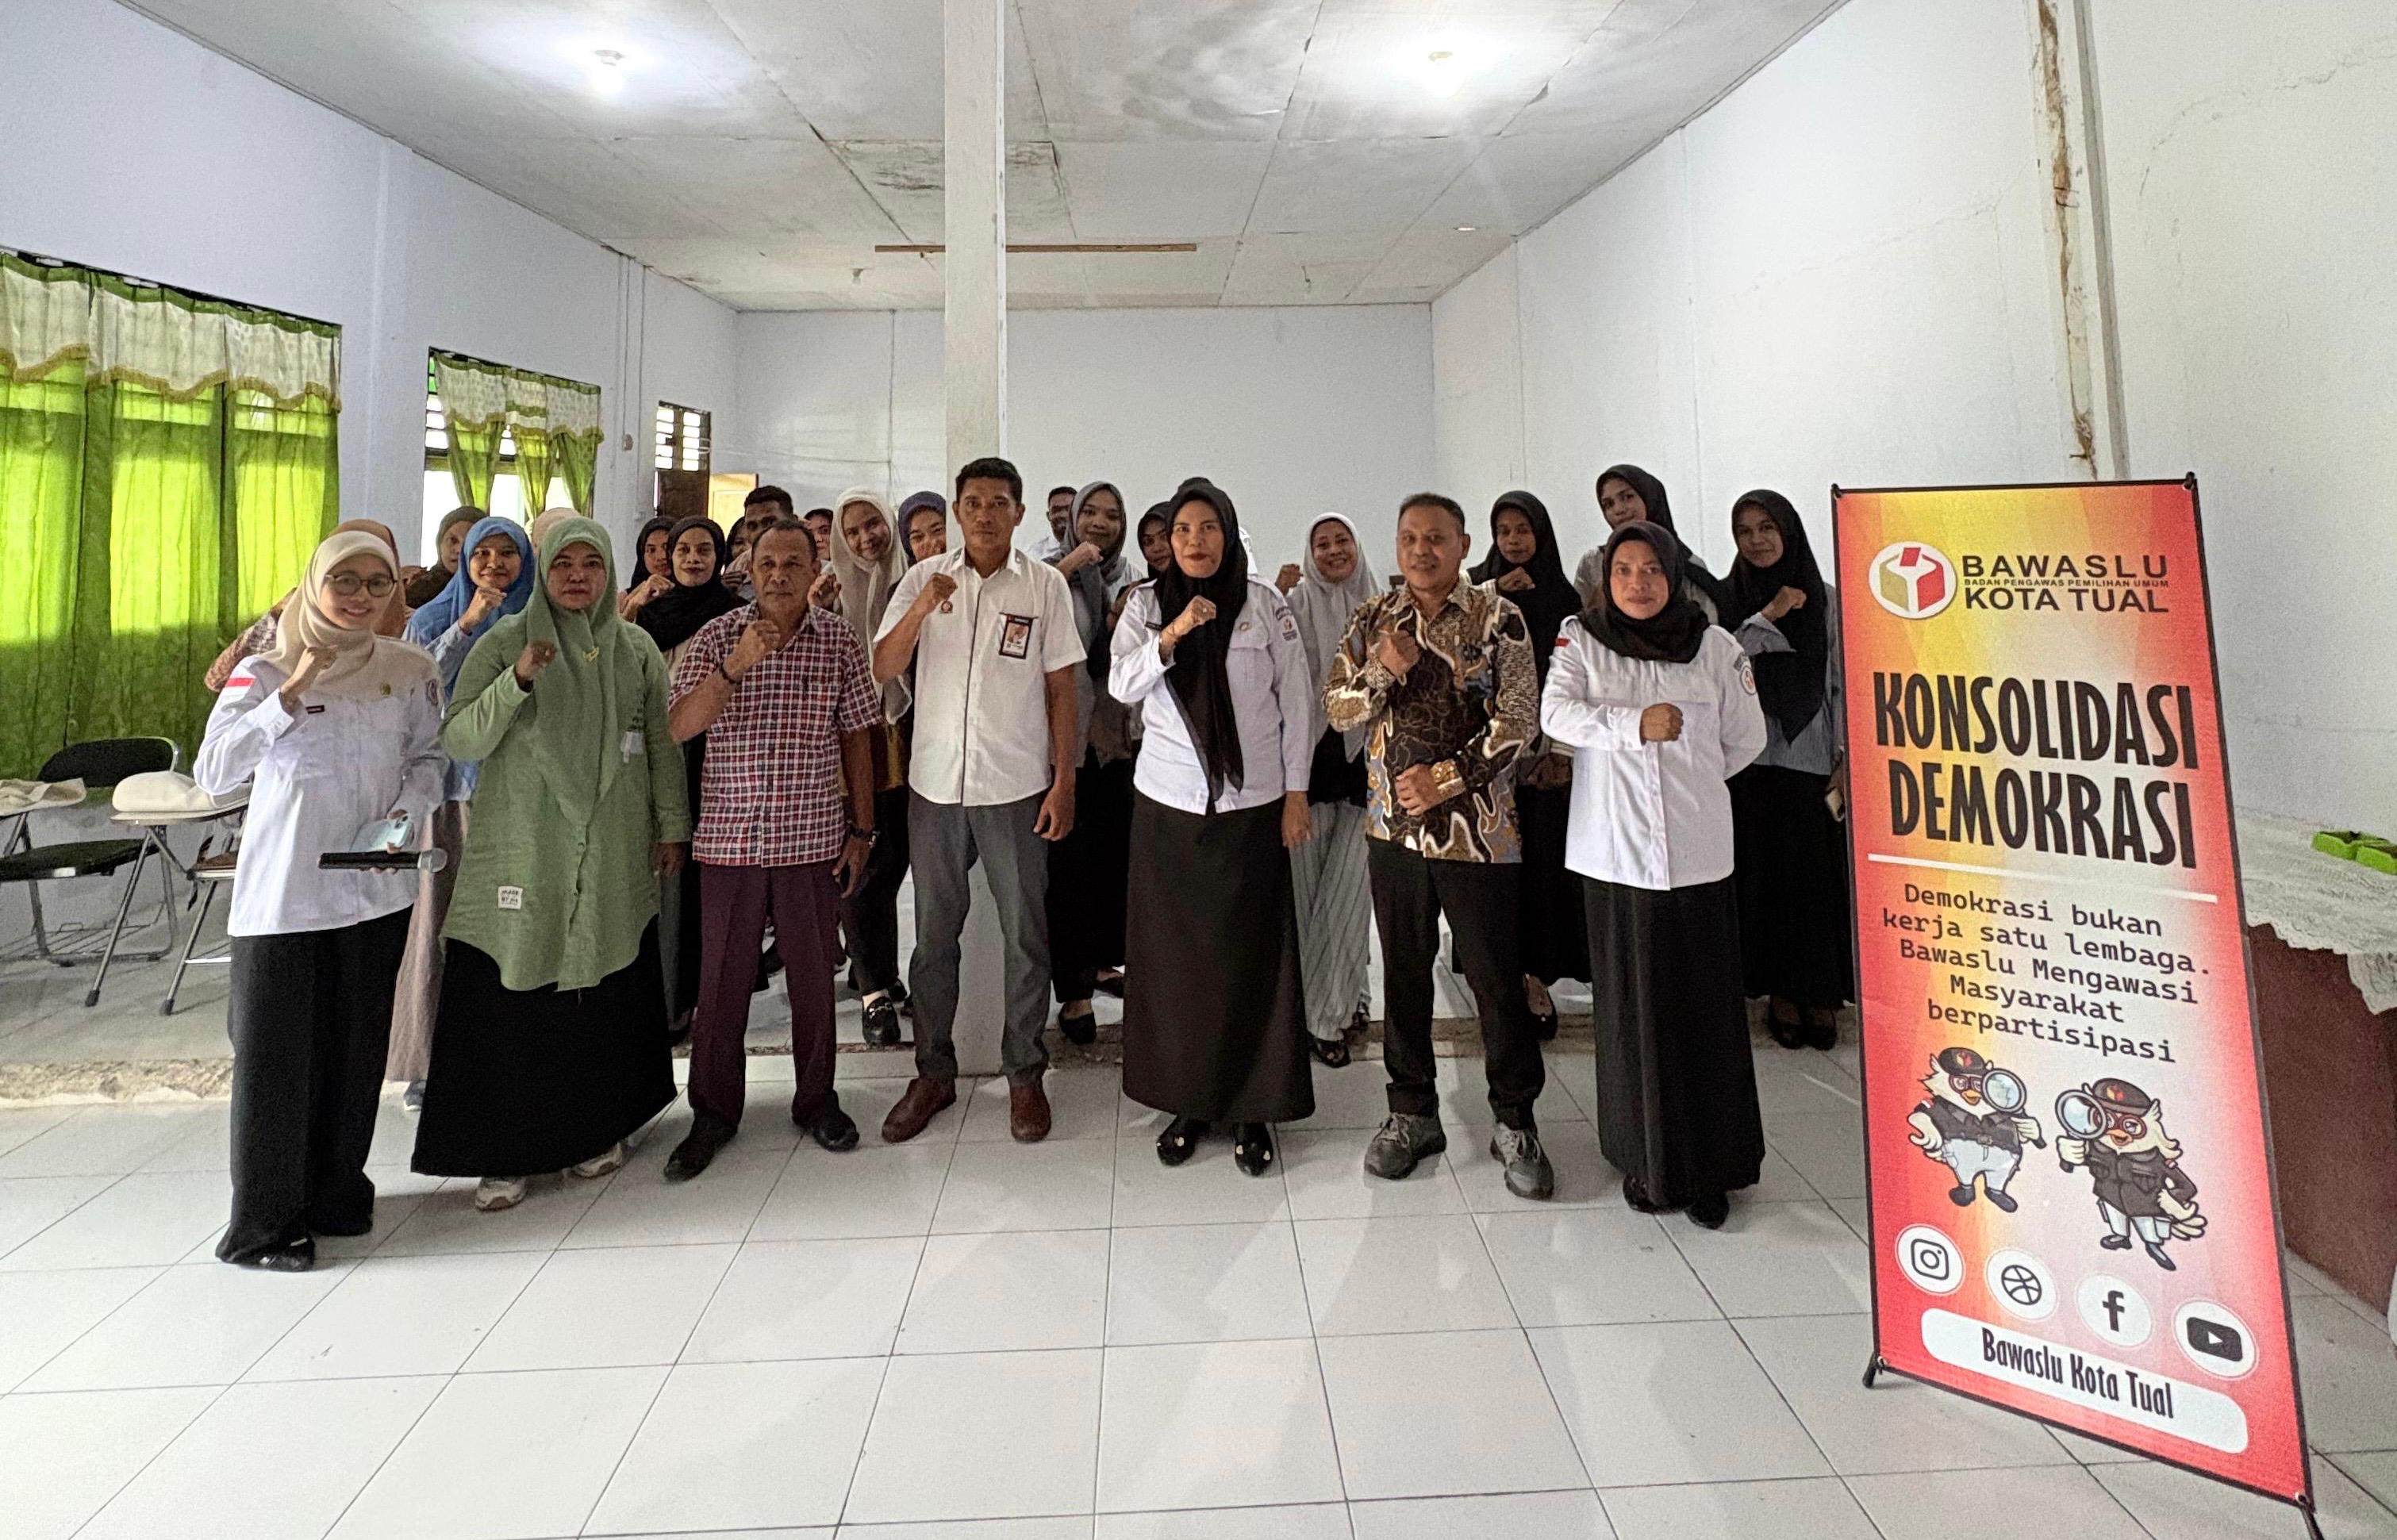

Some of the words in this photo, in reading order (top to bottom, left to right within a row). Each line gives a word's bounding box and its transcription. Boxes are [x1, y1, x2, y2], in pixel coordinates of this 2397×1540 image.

[1962, 555, 2168, 578] BAWASLU
[1965, 587, 2061, 611] KOTA
[2068, 588, 2169, 613] TUAL
[1873, 672, 2199, 770] KONSOLIDASI
[1888, 759, 2197, 870] DEMOKRASI
[1884, 908, 1963, 939] kerja
[1980, 923, 2048, 951] satu
[2065, 932, 2209, 975] lembaga.
[1904, 883, 2053, 922] Demokrasi
[2072, 904, 2161, 937] bukan
[1900, 939, 2014, 975] Bawaslu
[2033, 958, 2199, 1004] Mengawasi
[1950, 974, 2125, 1023] Masyarakat
[1928, 999, 2176, 1063] berpartisipasi
[1981, 1327, 2063, 1384] Bawaslu
[2069, 1354, 2119, 1403] Kota
[2126, 1370, 2174, 1419] Tual
